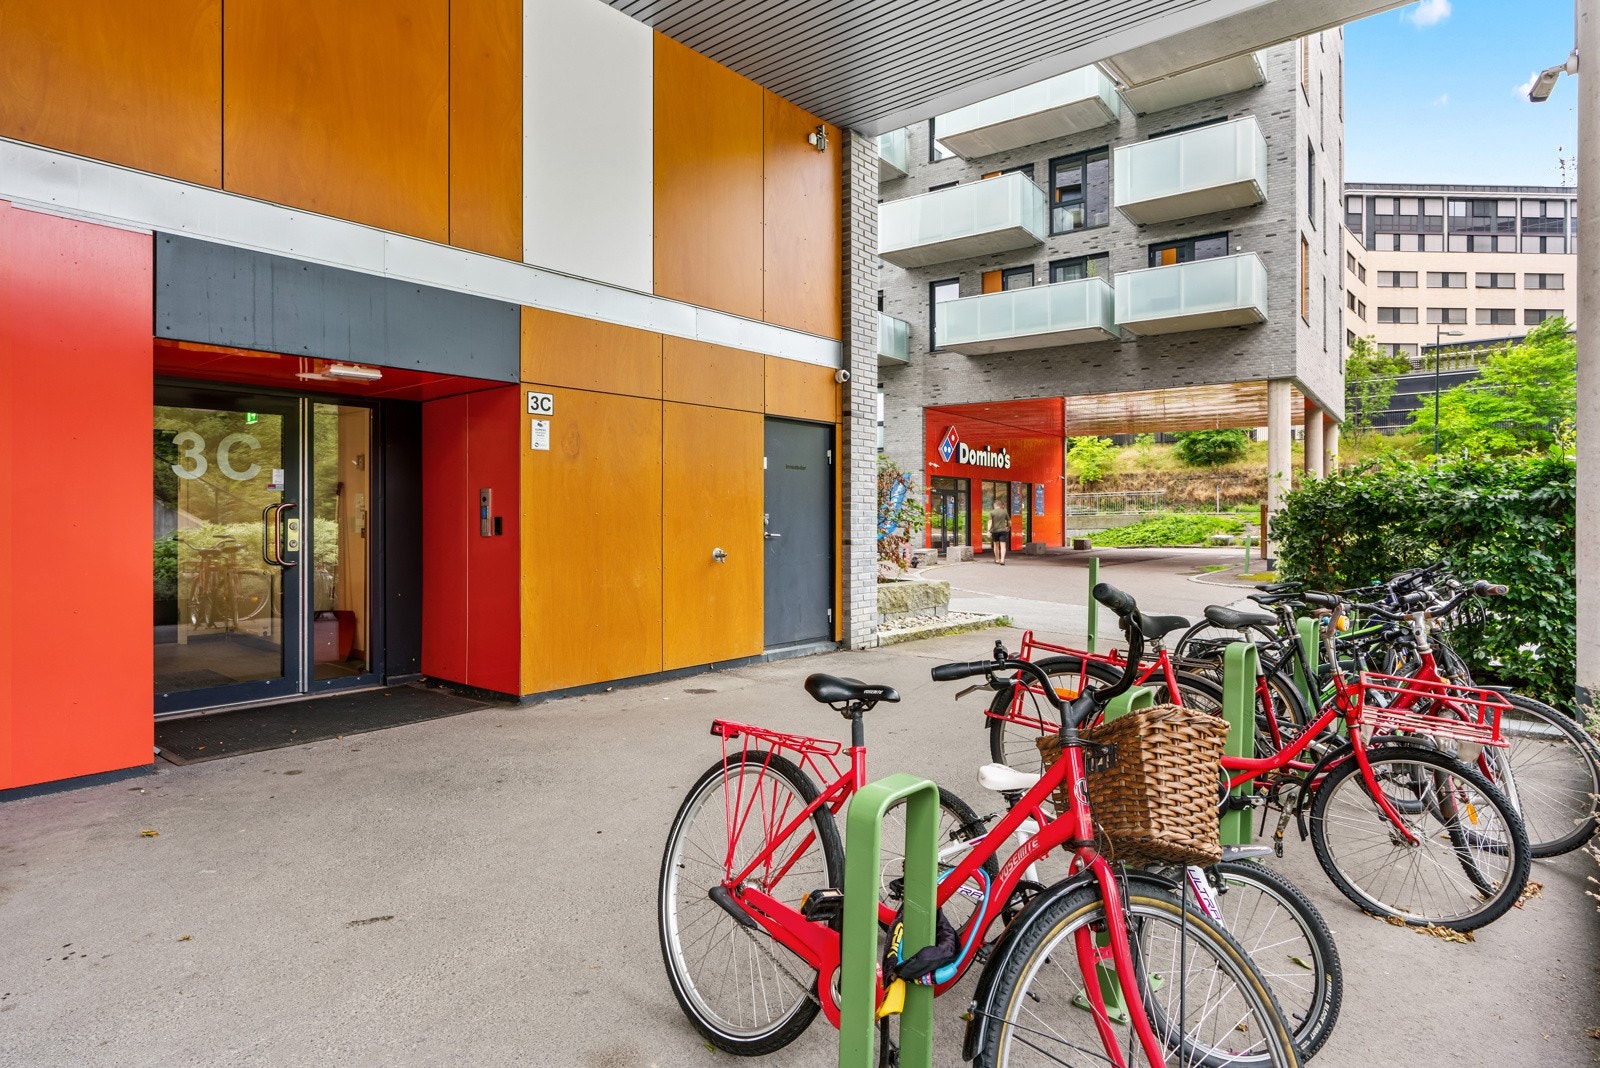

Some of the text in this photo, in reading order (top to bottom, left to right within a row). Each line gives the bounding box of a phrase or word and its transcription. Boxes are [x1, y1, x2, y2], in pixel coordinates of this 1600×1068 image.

[530, 396, 551, 411] 3C
[171, 431, 261, 481] 3C
[959, 442, 1011, 469] Domino's
[1000, 835, 1040, 882] YOSEMITE
[1187, 868, 1221, 920] ULTRA
